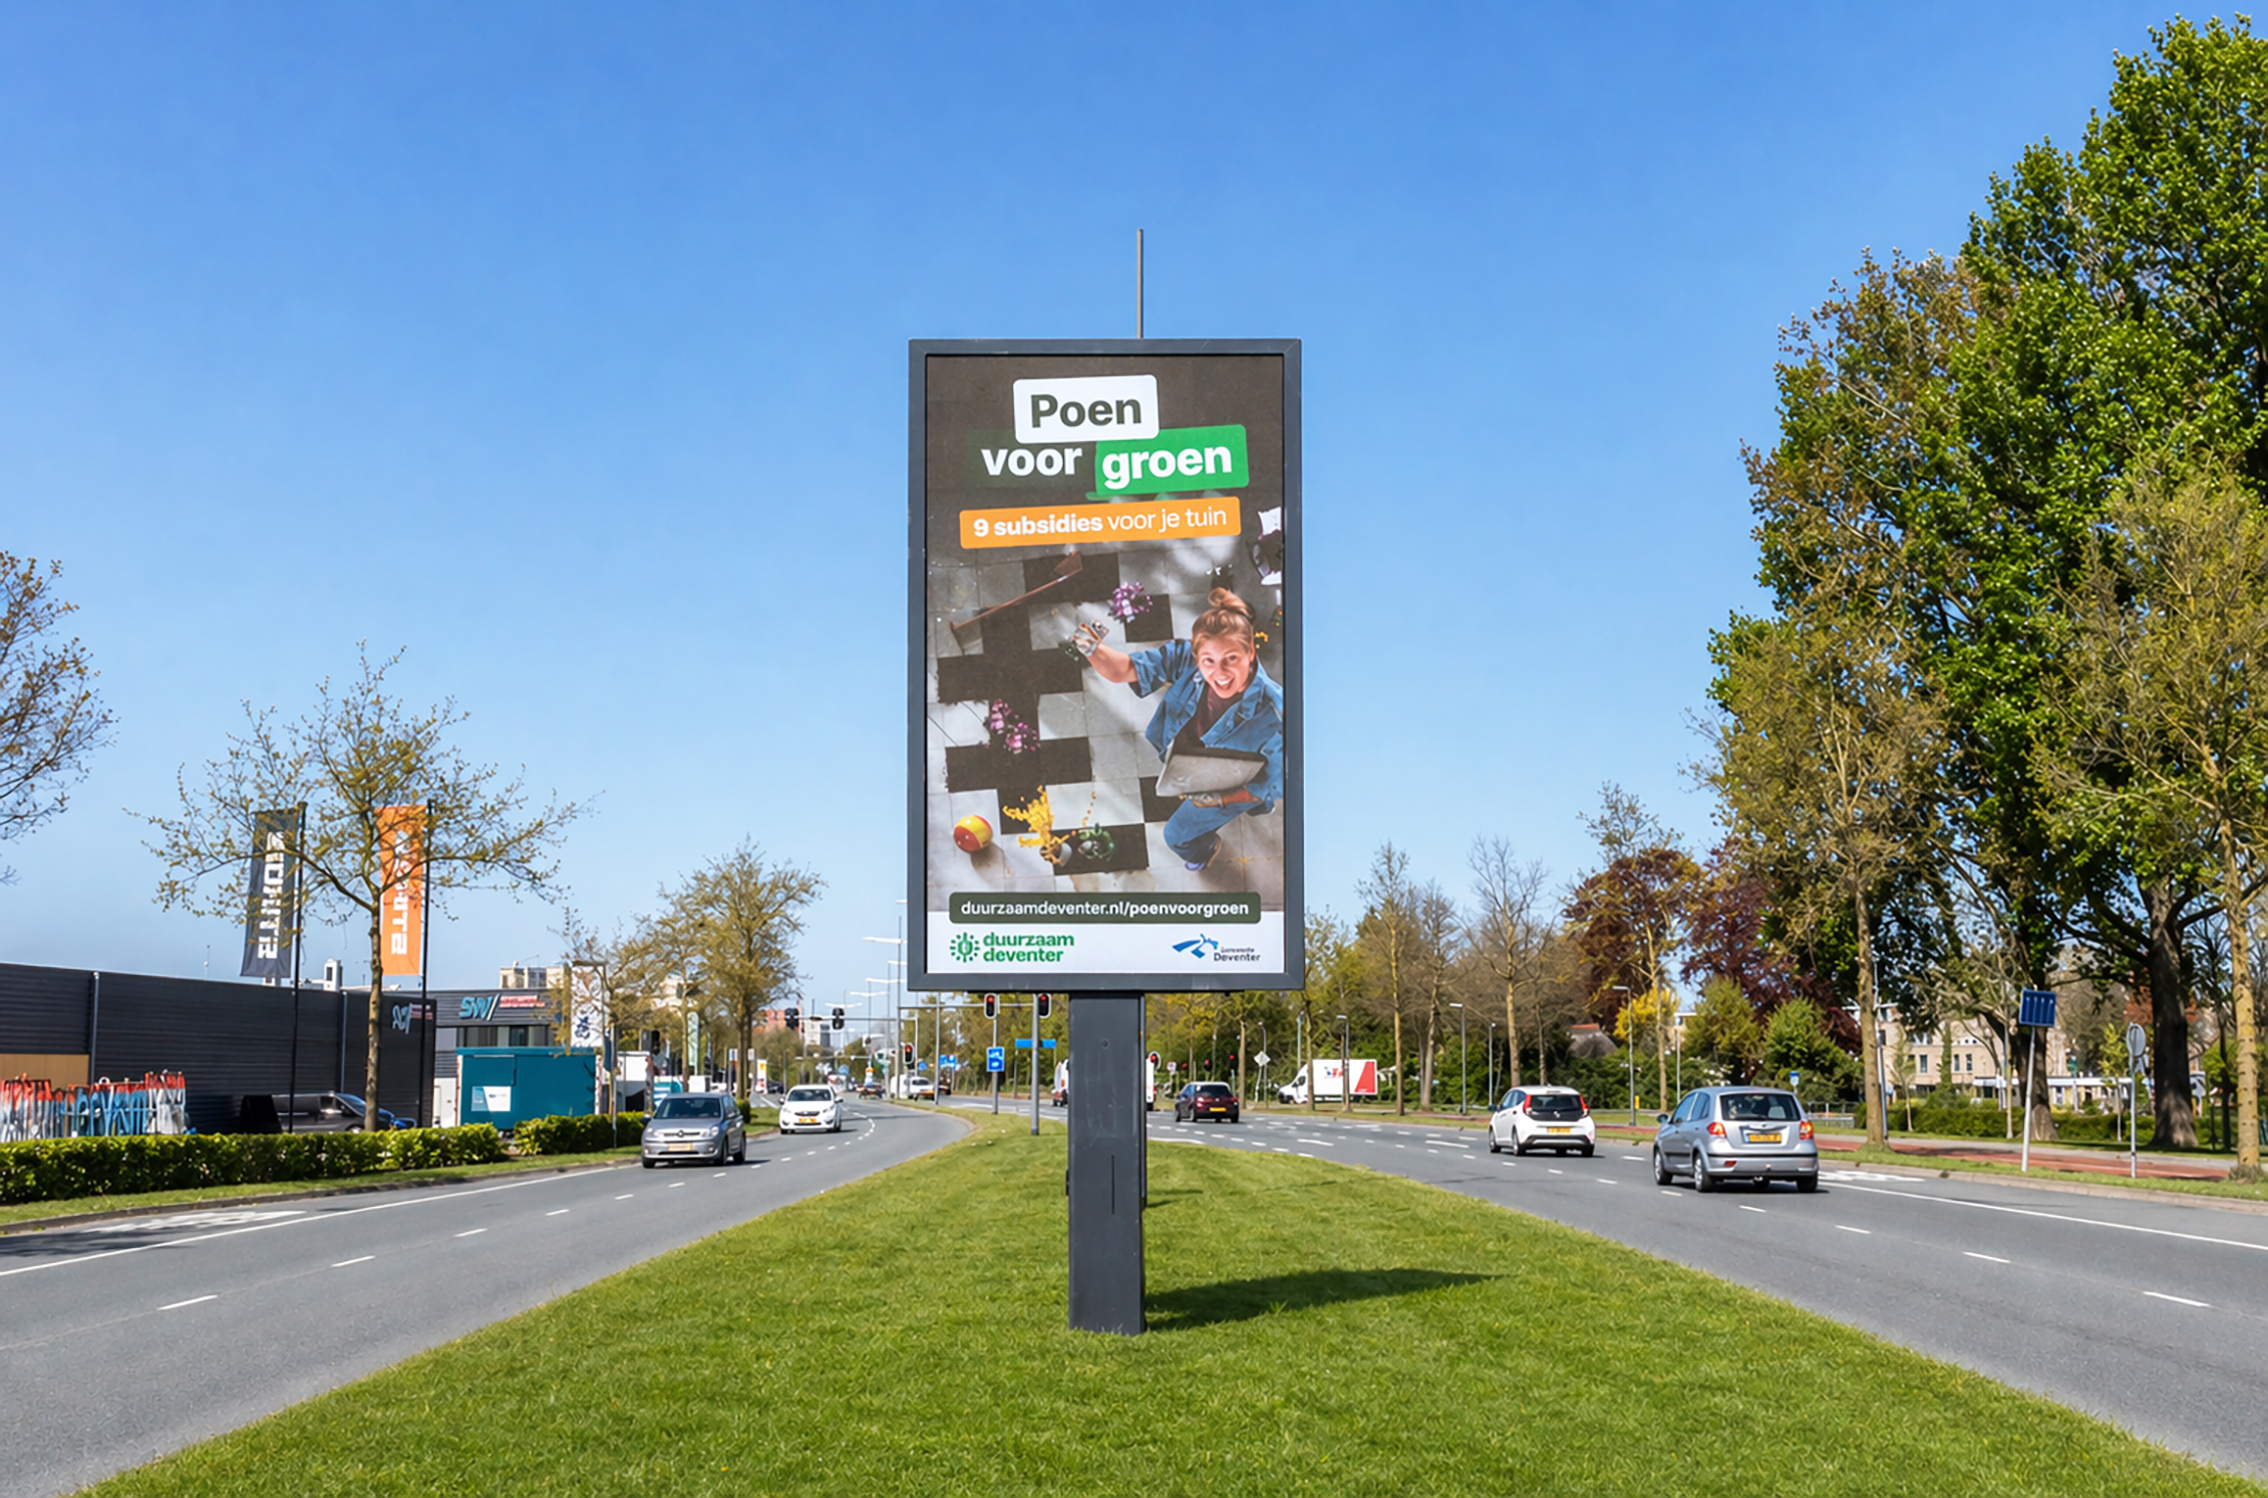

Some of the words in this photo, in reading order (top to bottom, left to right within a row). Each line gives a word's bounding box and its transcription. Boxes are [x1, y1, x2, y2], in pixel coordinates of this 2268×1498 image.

[1031, 394, 1142, 428] Poen
[980, 448, 1083, 477] voor
[1101, 445, 1233, 490] groen
[972, 518, 990, 538] 9
[993, 512, 1104, 537] subsidies
[1106, 513, 1157, 531] voor
[1158, 508, 1181, 534] je
[1184, 506, 1228, 528] tuin
[960, 900, 1250, 918] duurzaamdeventer.nl/poenvoorgroen
[982, 932, 1075, 947] duurzaam
[982, 947, 1065, 963] deventer
[1212, 952, 1261, 962] Deventer
